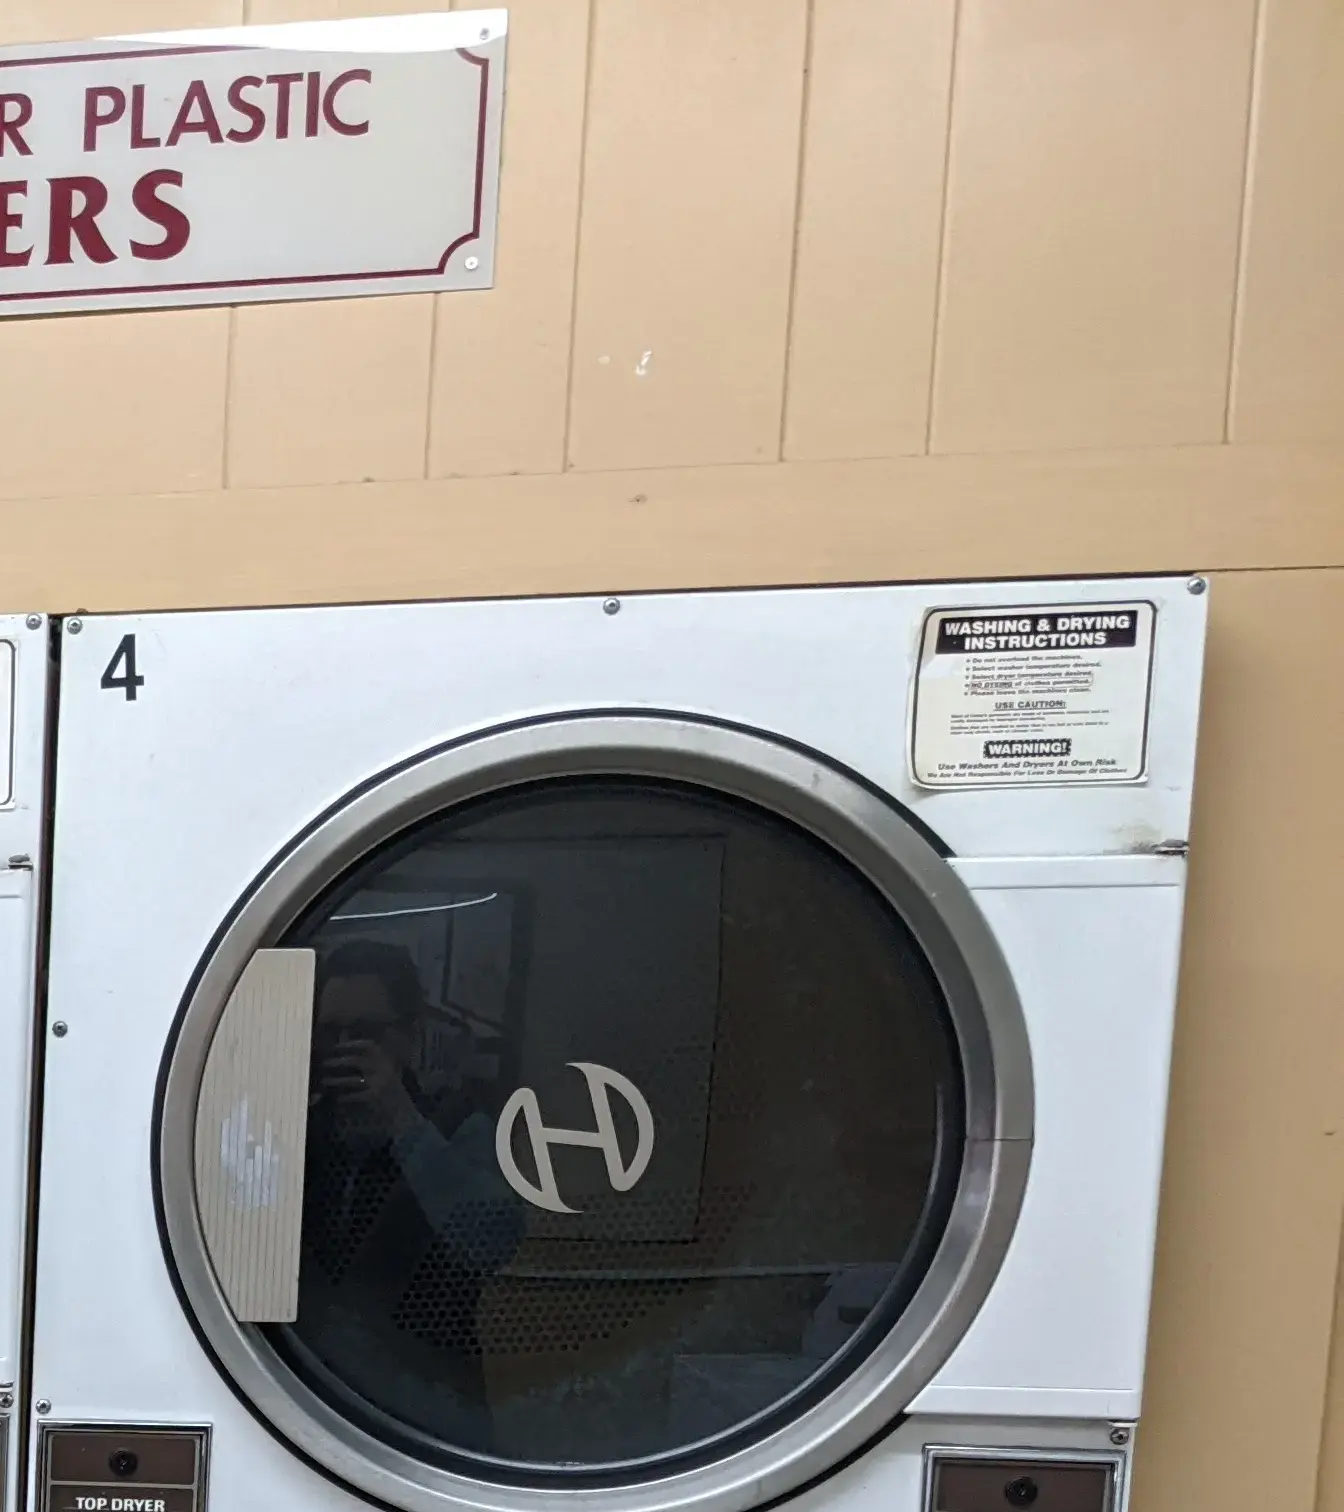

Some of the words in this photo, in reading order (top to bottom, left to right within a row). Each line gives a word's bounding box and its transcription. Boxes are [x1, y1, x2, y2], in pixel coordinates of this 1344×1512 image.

[84, 69, 373, 152] PLASTIC
[945, 620, 1031, 636] WASHING
[1037, 618, 1050, 631] &
[1057, 615, 1130, 631] DRYING
[964, 632, 1107, 650] INSTRUCTIONS
[101, 634, 144, 701] 4
[995, 701, 1013, 709] USE
[988, 741, 1068, 755] WARNING!
[1023, 760, 1055, 768] Dryers
[1095, 758, 1116, 766] Risk
[76, 1497, 107, 1511] TOP
[112, 1498, 165, 1512] DRYER
